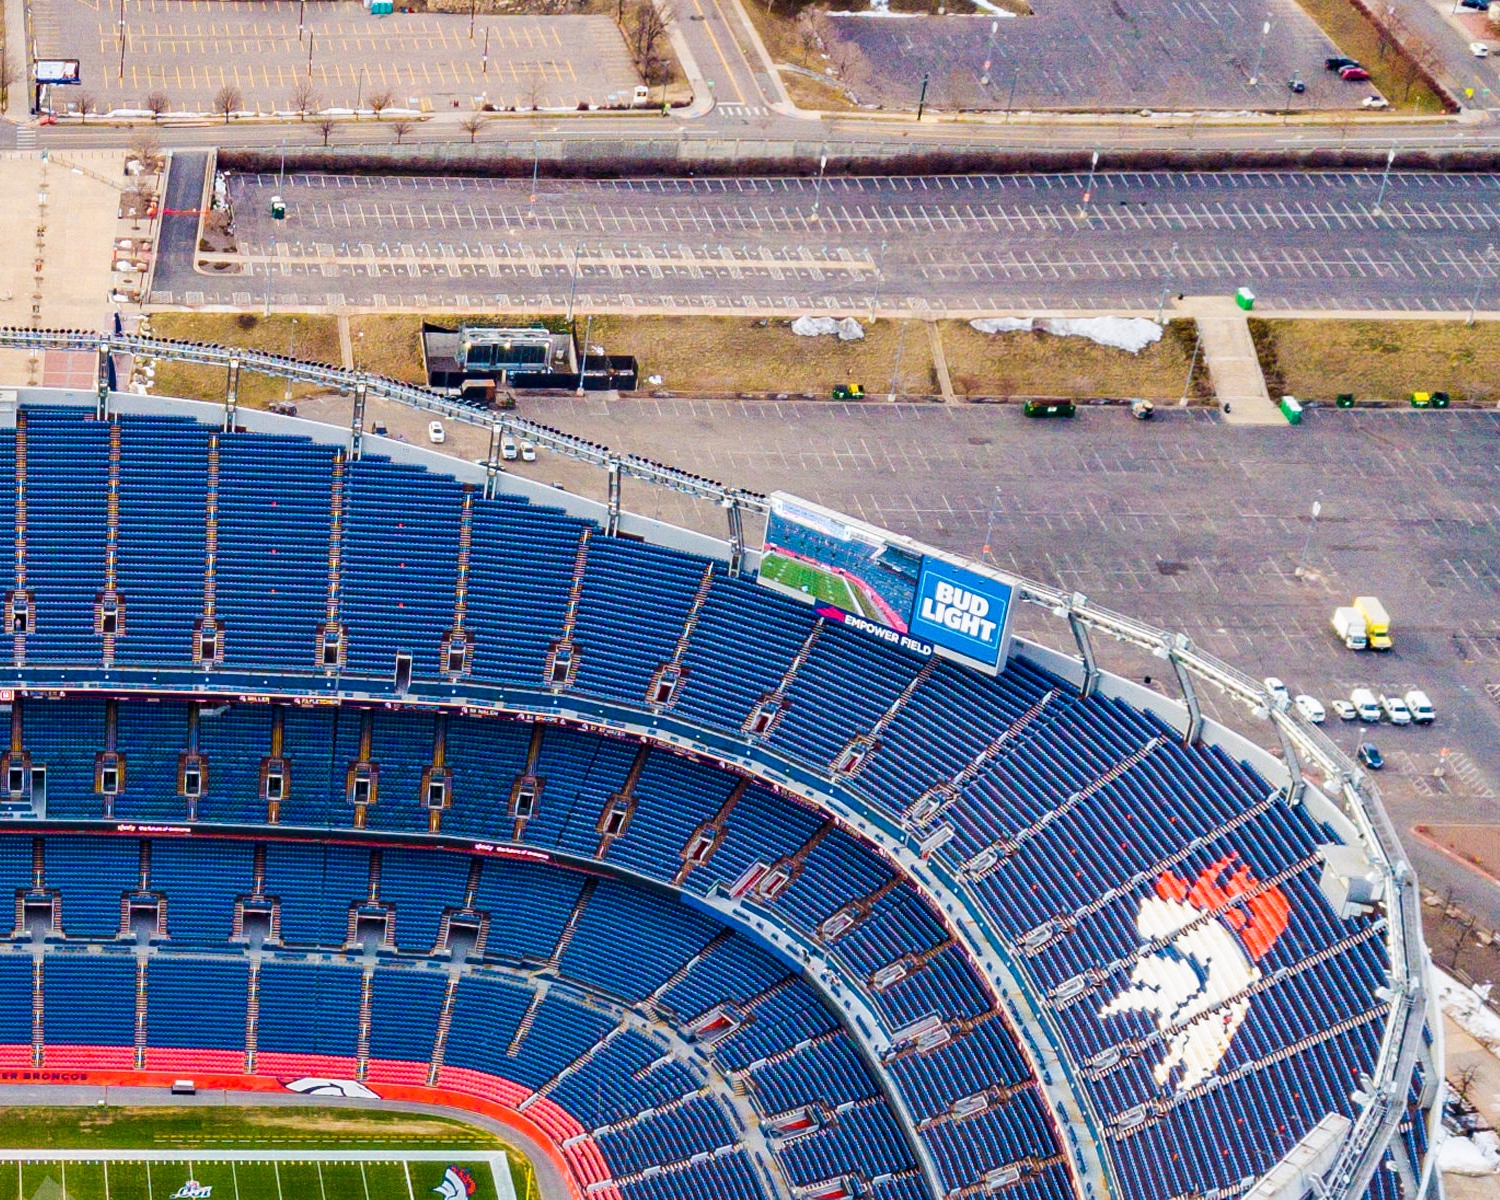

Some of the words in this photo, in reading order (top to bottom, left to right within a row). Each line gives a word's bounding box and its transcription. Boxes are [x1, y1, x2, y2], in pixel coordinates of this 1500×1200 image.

[934, 580, 990, 619] BUD
[844, 614, 900, 644] EMPOWER
[900, 634, 933, 657] FIELD
[23, 1072, 88, 1081] BRONCOS
